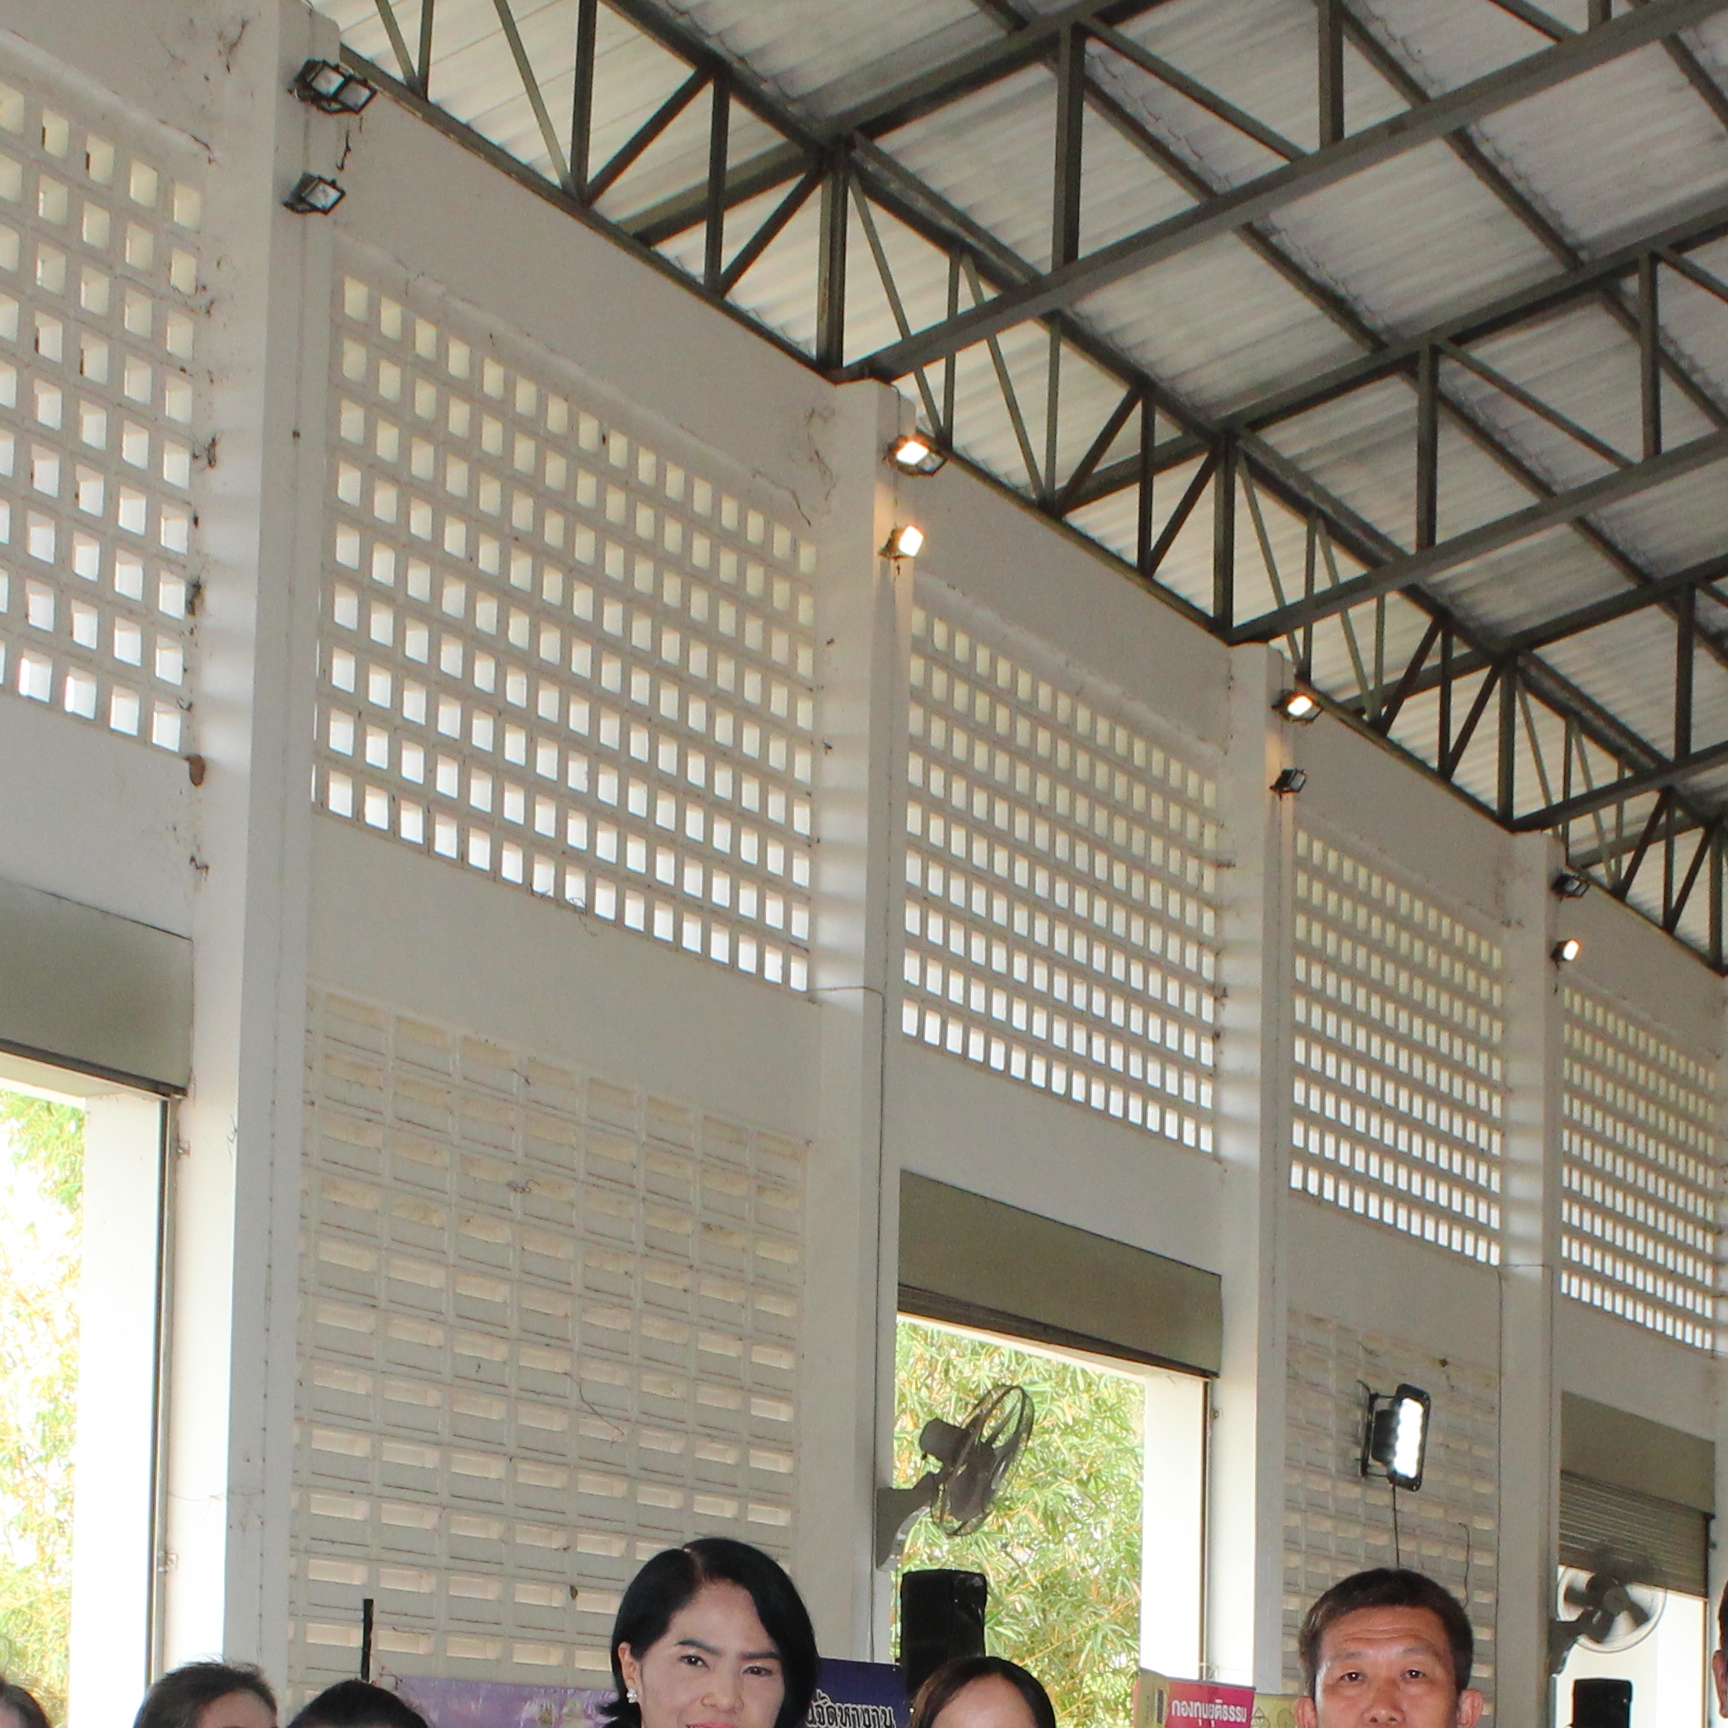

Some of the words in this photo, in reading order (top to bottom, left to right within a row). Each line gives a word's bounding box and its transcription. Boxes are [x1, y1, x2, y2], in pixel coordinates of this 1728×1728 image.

[1171, 1698, 1248, 1728] กองทุนยุติธรรม
